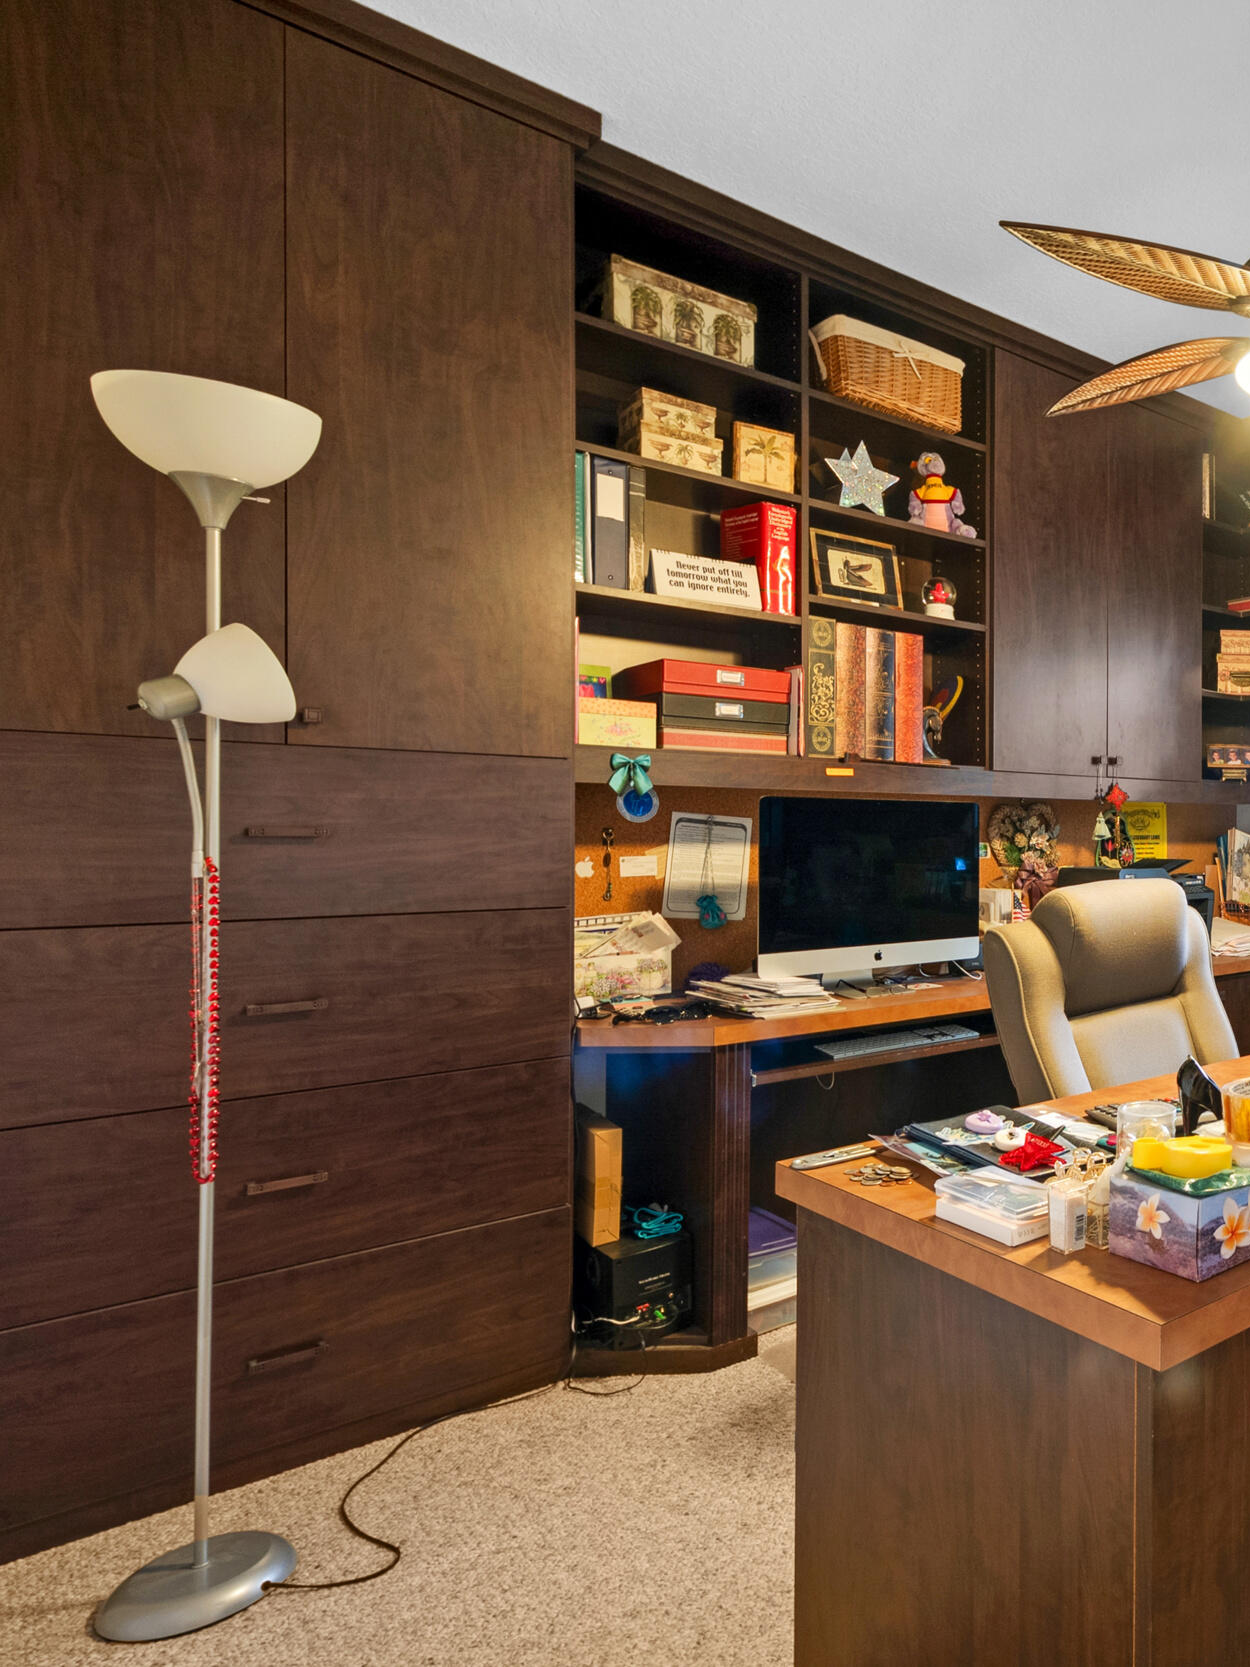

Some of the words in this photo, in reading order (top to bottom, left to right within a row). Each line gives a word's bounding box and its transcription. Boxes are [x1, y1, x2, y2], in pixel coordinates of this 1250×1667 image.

[666, 568, 709, 581] tomorrow
[710, 575, 731, 585] what
[732, 580, 748, 588] you
[676, 560, 700, 572] Never
[702, 566, 716, 575] put
[718, 568, 730, 576] off
[731, 569, 743, 579] till
[668, 579, 684, 587] can
[687, 580, 714, 591] ignore
[717, 585, 750, 598] entirely.
